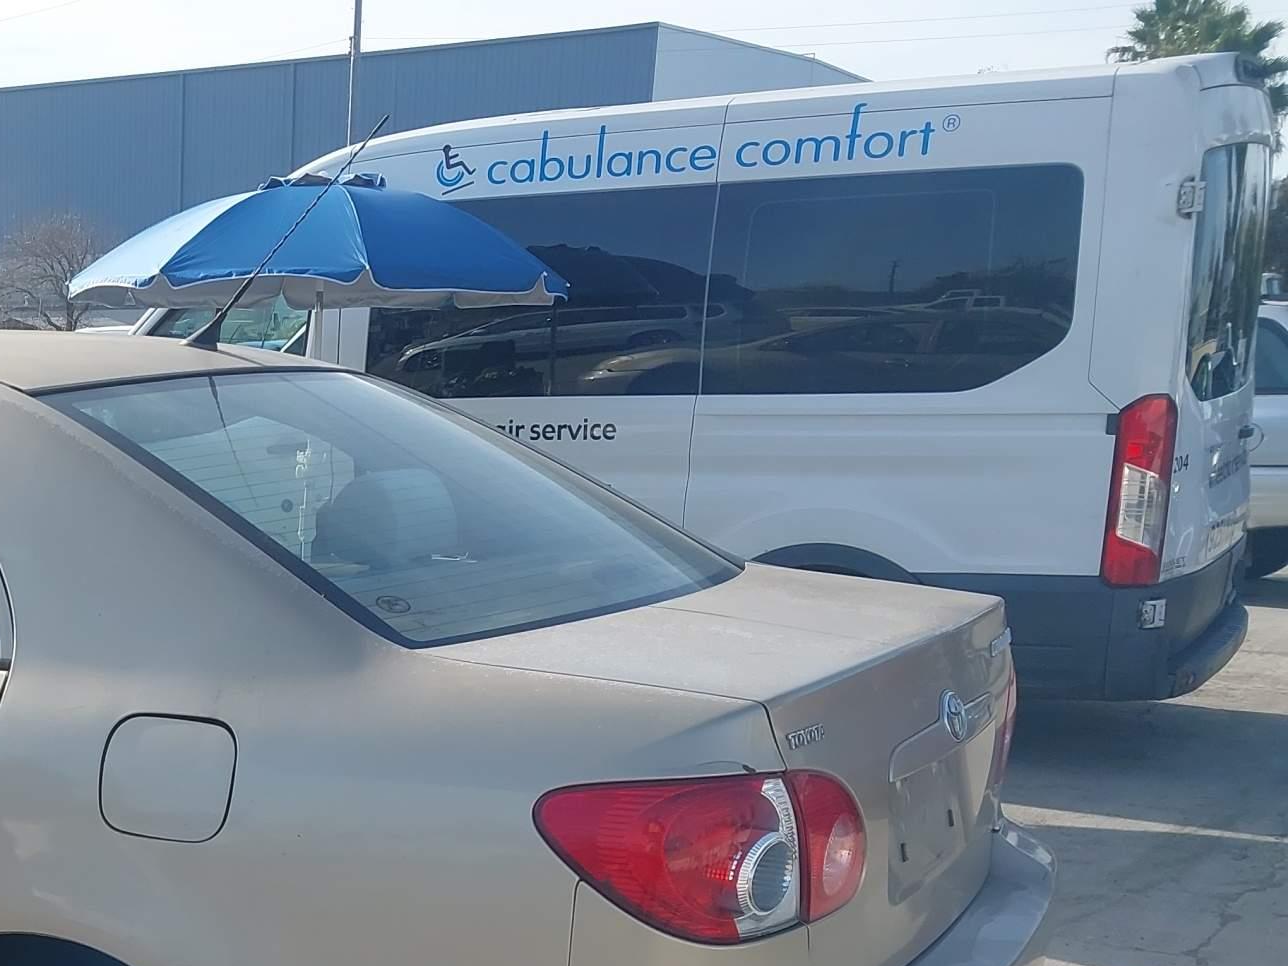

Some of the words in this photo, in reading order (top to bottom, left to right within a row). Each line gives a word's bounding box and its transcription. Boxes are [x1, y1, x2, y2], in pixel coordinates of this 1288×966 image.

[487, 125, 717, 185] cabulance
[494, 419, 525, 438] ir
[529, 418, 617, 441] service
